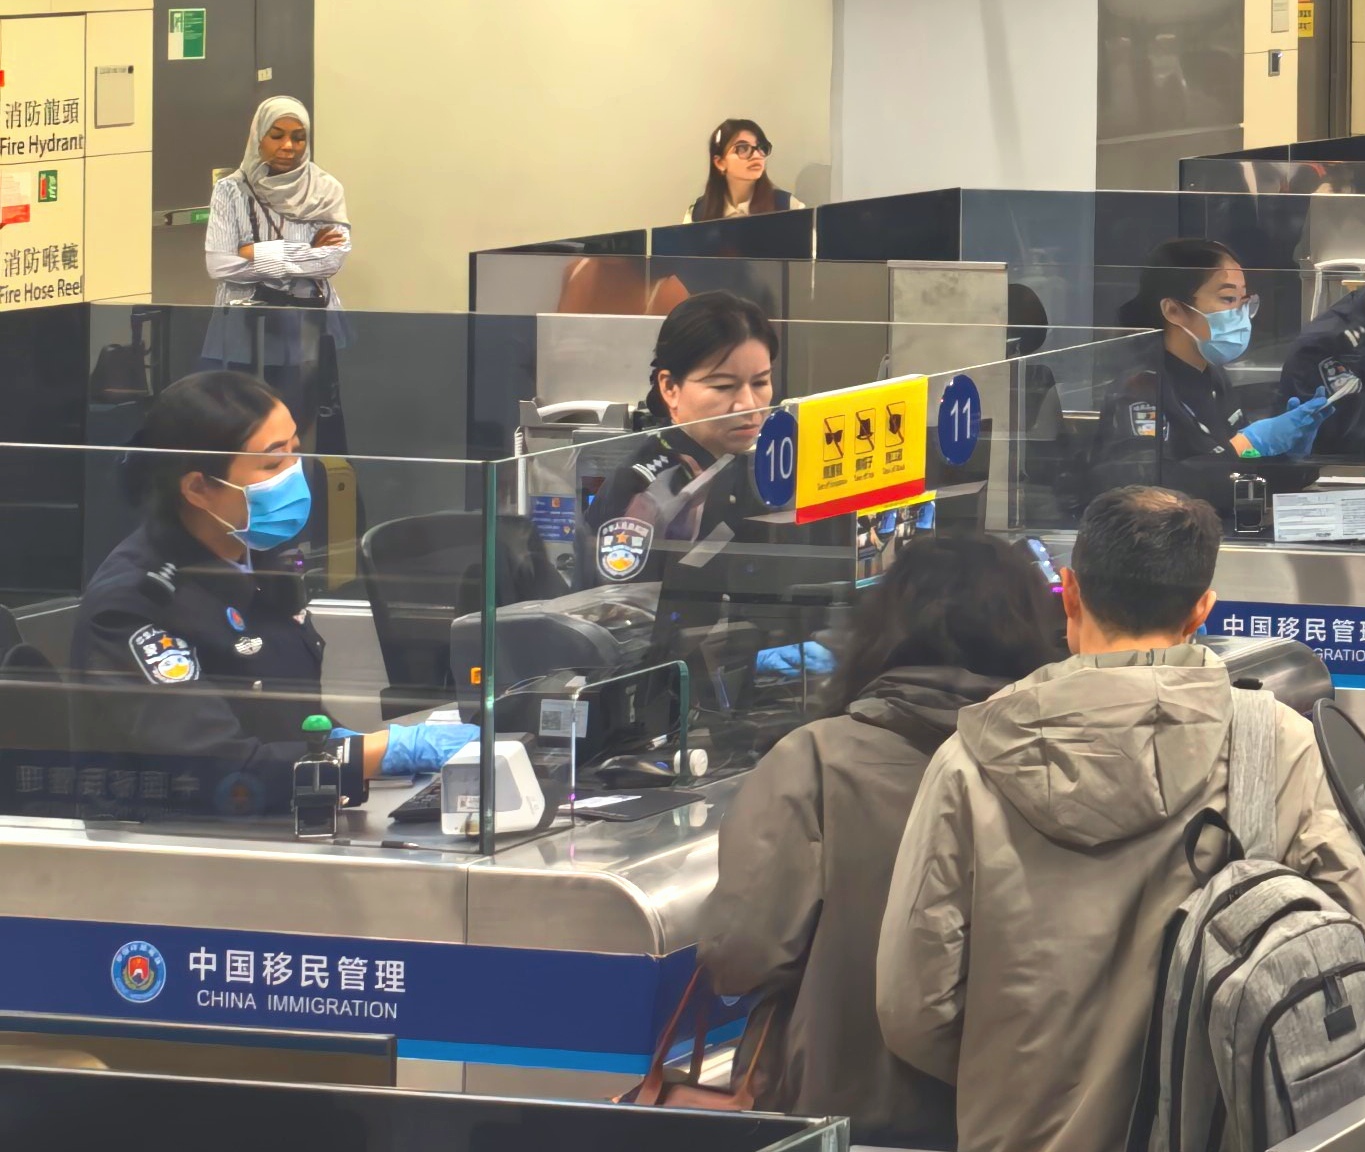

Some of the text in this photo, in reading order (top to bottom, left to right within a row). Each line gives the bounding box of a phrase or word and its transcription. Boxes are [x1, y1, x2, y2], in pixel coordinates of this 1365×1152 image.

[5, 98, 79, 129] 消防龍頭
[0, 133, 84, 158] Fire Hydrant
[24, 282, 54, 301] Hose
[58, 276, 82, 296] Reel
[950, 398, 972, 442] 11
[766, 437, 793, 482] 10
[188, 946, 406, 993] 中国移民管理
[196, 990, 398, 1019] CHINA IMMIGRATION
